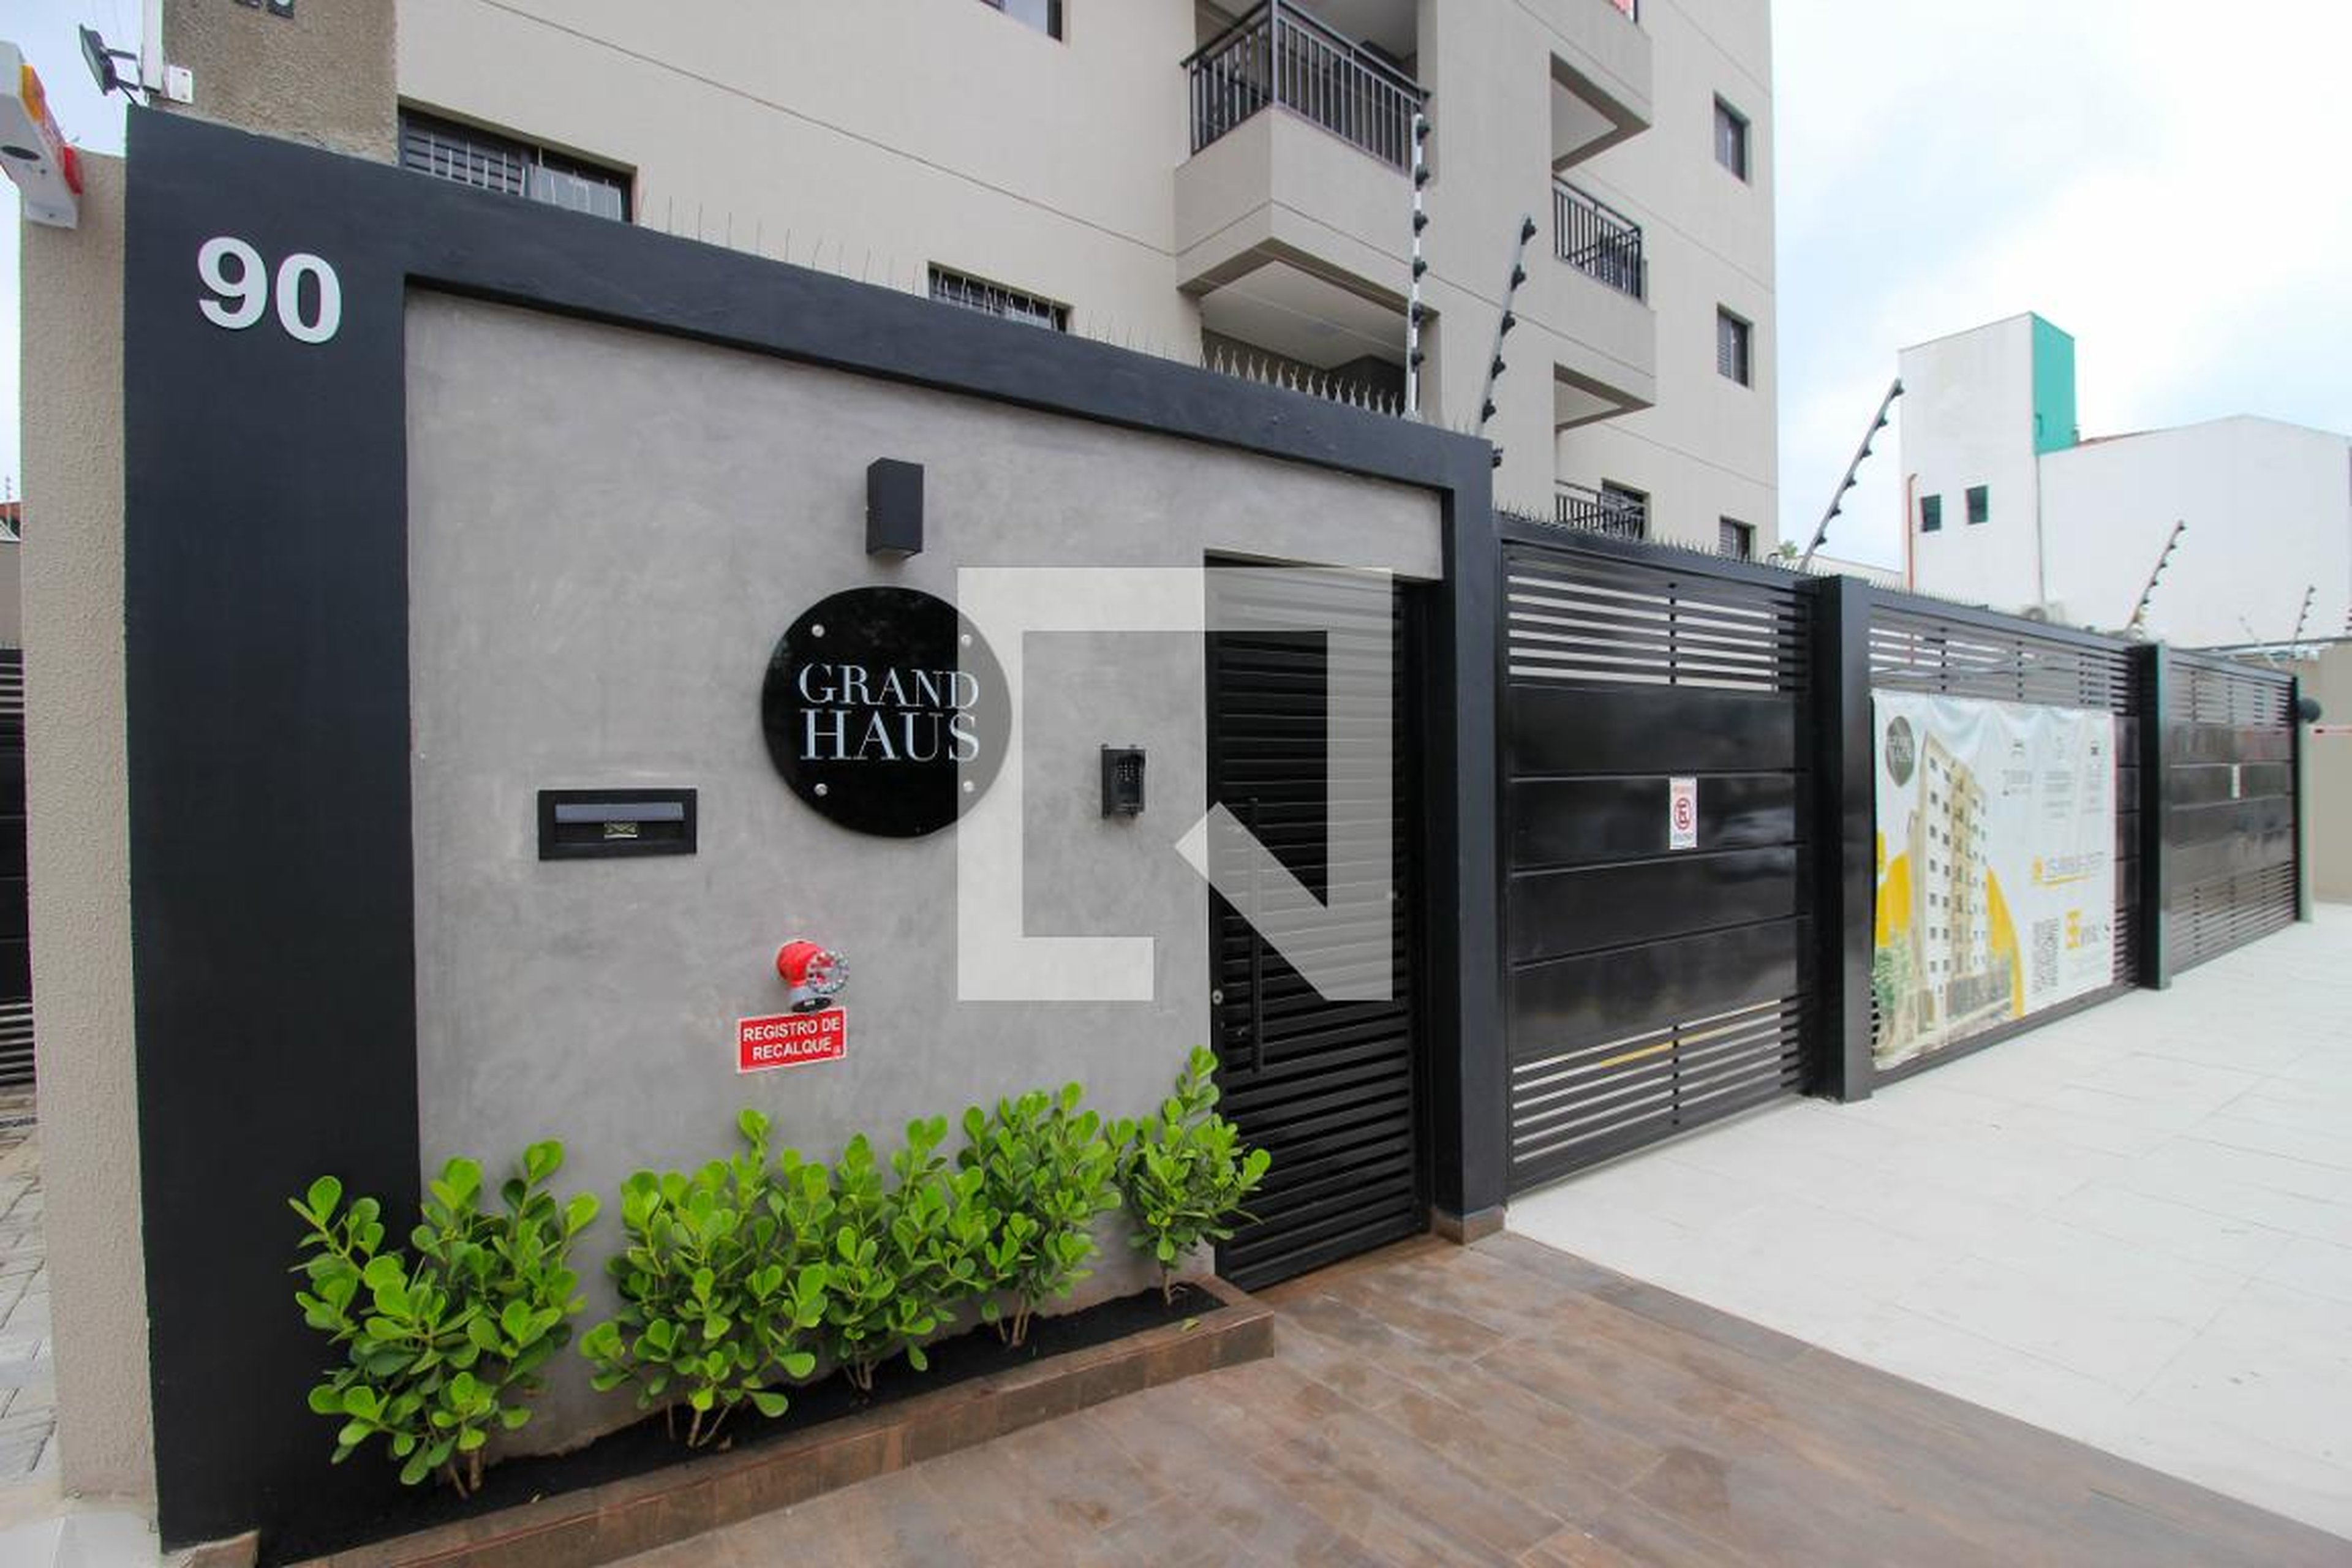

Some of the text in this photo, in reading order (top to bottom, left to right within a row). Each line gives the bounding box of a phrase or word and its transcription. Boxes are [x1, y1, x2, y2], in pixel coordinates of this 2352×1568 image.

[198, 236, 342, 344] 90
[799, 663, 979, 709] GRAND
[799, 709, 979, 762] HAUS
[742, 1016, 841, 1042] REGISTRO DE
[753, 1036, 832, 1060] RECALQUE
